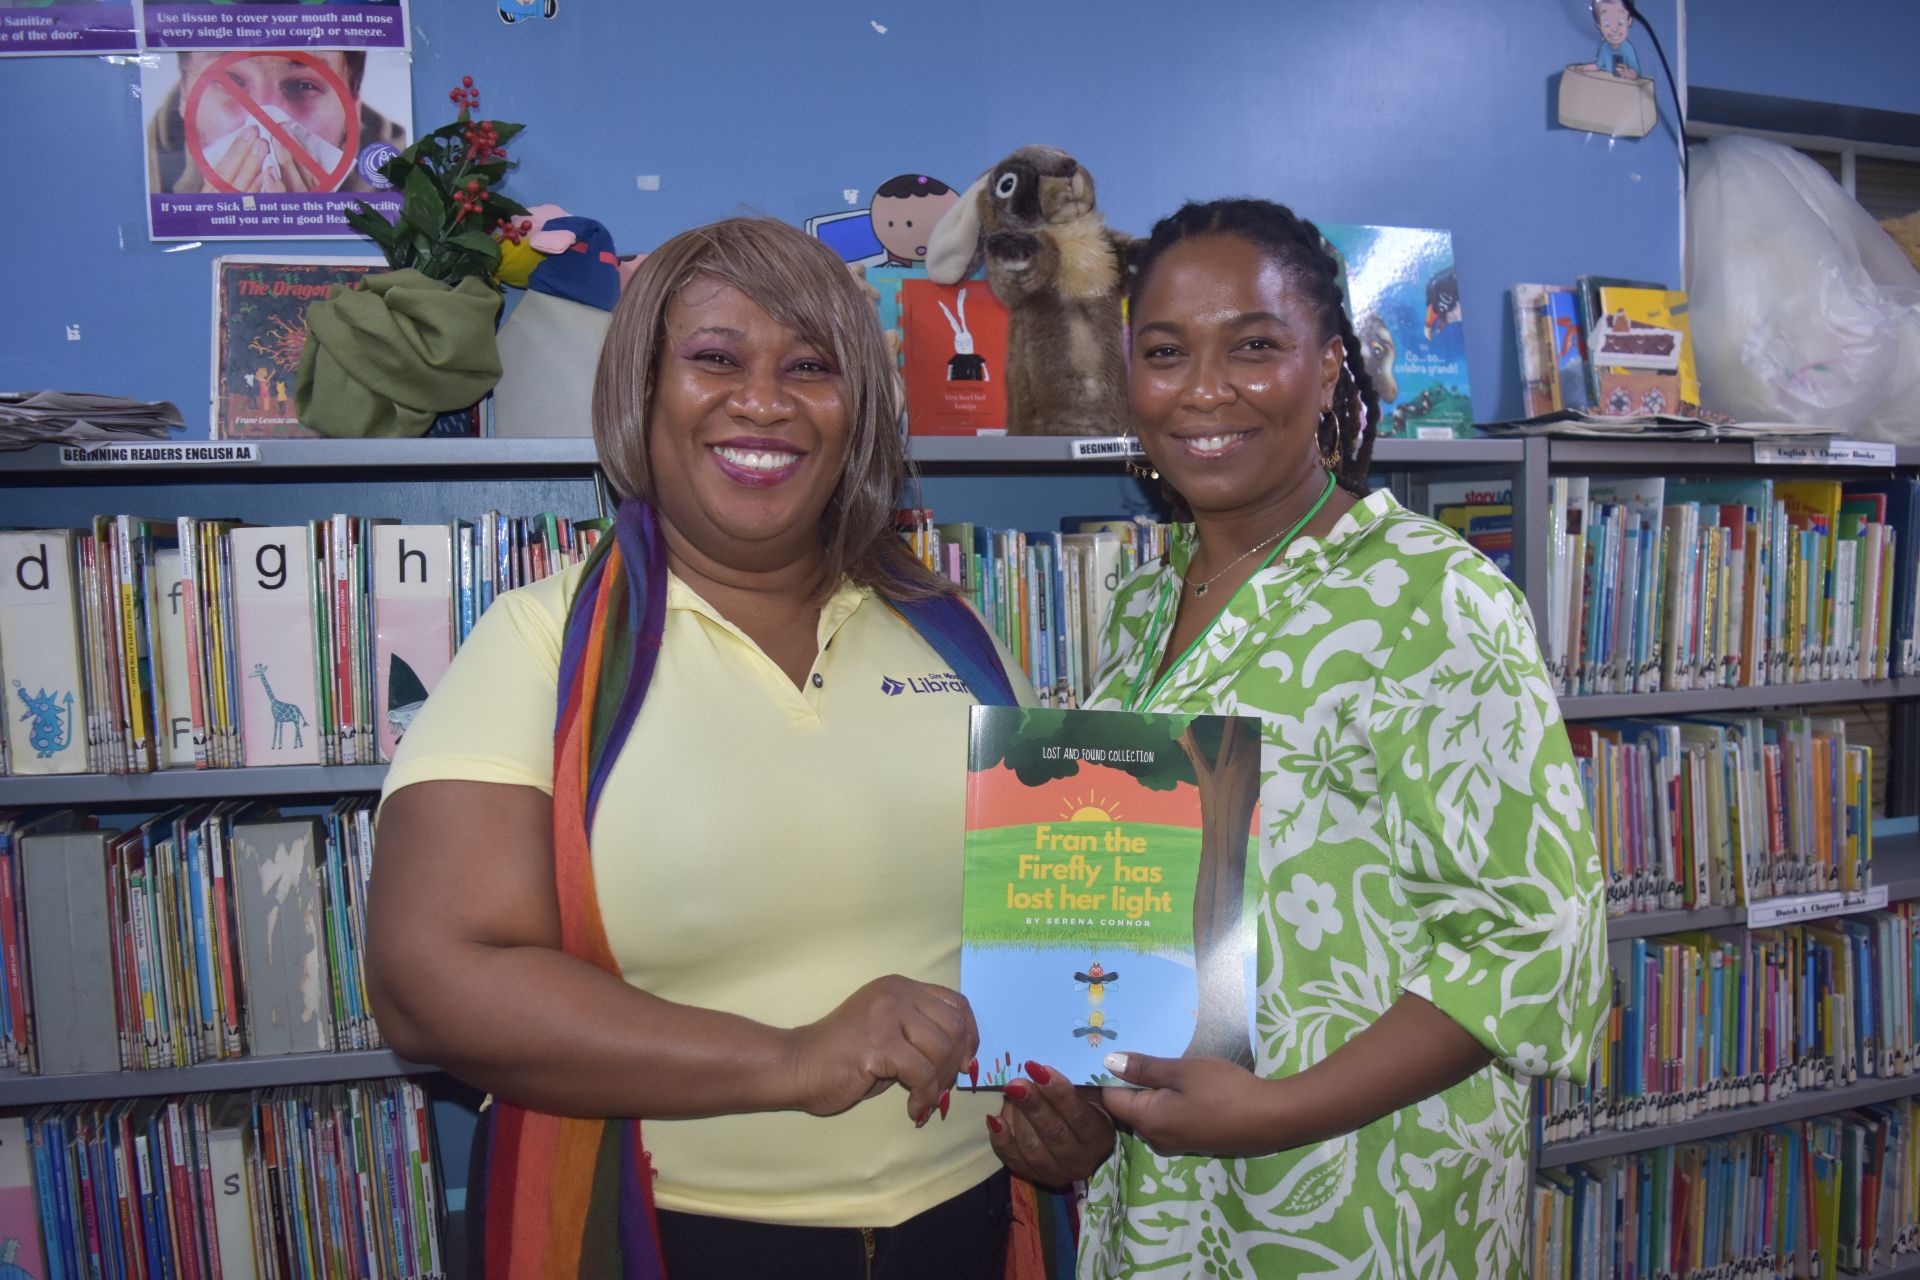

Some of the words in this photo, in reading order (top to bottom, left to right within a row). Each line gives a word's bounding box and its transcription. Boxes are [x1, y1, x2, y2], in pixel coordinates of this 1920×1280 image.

[157, 13, 179, 23] Use
[182, 13, 218, 23] tissue
[221, 13, 233, 23] to
[236, 14, 268, 23] cover
[272, 14, 298, 25] your
[302, 13, 337, 23] mouth
[341, 13, 362, 23] and
[366, 15, 393, 24] nose
[12, 31, 24, 41] of
[28, 31, 47, 41] the
[51, 30, 83, 41] door.
[162, 28, 194, 39] every
[197, 27, 233, 39] single
[236, 27, 262, 37] time
[265, 29, 286, 39] you
[290, 26, 325, 38] cough
[328, 27, 341, 36] or
[344, 28, 386, 37] sneeze.
[161, 202, 170, 212] If
[172, 204, 192, 214] you
[195, 204, 214, 212] are
[216, 202, 240, 212] Sick
[260, 203, 278, 212] not
[281, 203, 300, 212] use
[303, 201, 323, 212] this
[326, 201, 360, 212] Public
[364, 201, 400, 213] acility
[211, 215, 236, 225] until
[239, 216, 259, 226] you
[262, 216, 280, 224] are
[283, 214, 293, 224] in
[297, 214, 323, 226] good
[326, 214, 350, 224] Hea
[239, 280, 269, 296] The
[272, 281, 330, 300] Dragon
[64, 447, 128, 462] BEGINNING
[130, 447, 182, 461] READERS
[185, 446, 233, 460] ENGLISH
[236, 446, 251, 459] AA
[1777, 448, 1807, 459] English
[1820, 448, 1849, 460] Chapter
[1852, 450, 1875, 459] Books
[16, 544, 49, 590] d
[256, 543, 287, 589] g
[400, 539, 427, 582] h
[1104, 563, 1119, 591] d
[168, 582, 182, 615] f
[172, 718, 191, 749] F
[1042, 746, 1061, 760] LOST
[1064, 746, 1079, 760] AND
[1081, 748, 1106, 762] FOUND
[1108, 748, 1155, 764] COLLECTION
[1036, 826, 1097, 852] Fran
[1104, 827, 1147, 854] the
[1019, 854, 1101, 888] Firefly
[1115, 856, 1163, 883] has
[1007, 883, 1054, 910] lost
[1060, 884, 1105, 911] her
[1111, 885, 1173, 919] light
[1776, 907, 1798, 917] Dutch
[1811, 902, 1840, 913] Chapter
[1843, 898, 1866, 908] Books
[1026, 917, 1040, 926] BY
[1046, 917, 1094, 927] SERENA
[1100, 918, 1151, 928] CONNOR
